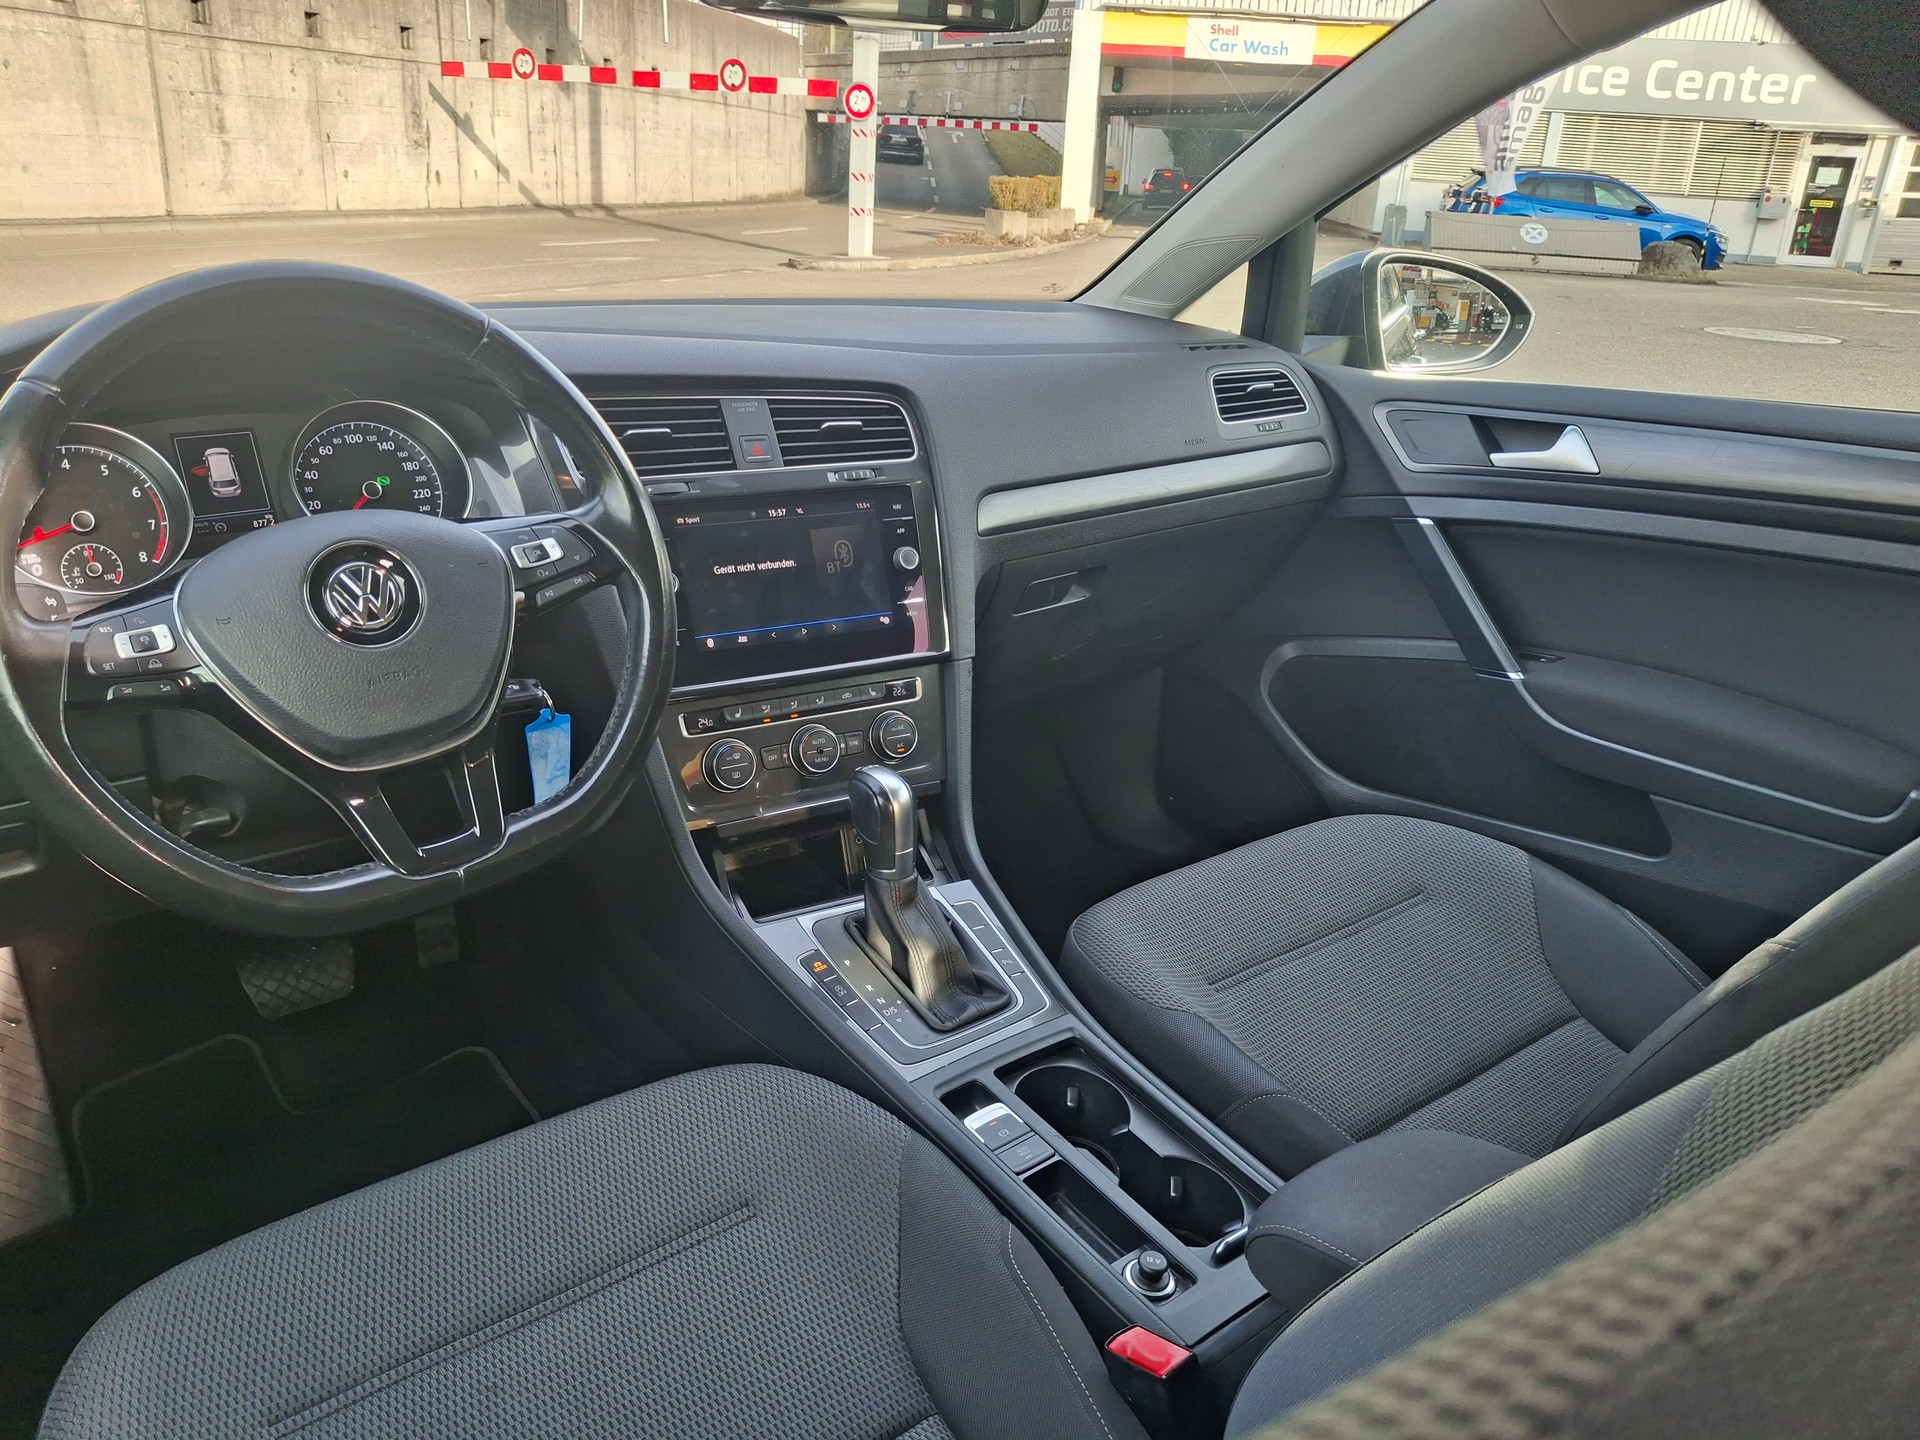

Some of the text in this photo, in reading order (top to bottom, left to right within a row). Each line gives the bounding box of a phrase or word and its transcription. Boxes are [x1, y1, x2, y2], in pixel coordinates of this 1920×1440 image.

[1210, 24, 1239, 36] Shell
[1209, 37, 1289, 56] Car Wash
[1645, 59, 1817, 105] Center
[332, 437, 342, 445] 80
[343, 433, 363, 444] 100
[318, 445, 333, 456] 60
[376, 441, 395, 452] 140
[61, 458, 71, 470] 4
[310, 457, 320, 465] 50
[401, 461, 420, 472] 180
[101, 464, 109, 476] 5
[304, 470, 319, 480] 40
[132, 486, 142, 498] 6
[413, 488, 431, 499] 220
[307, 500, 322, 510] 20
[685, 508, 787, 525] Sport 15:57
[148, 519, 156, 531] 7
[138, 551, 148, 563] 8
[532, 548, 543, 557] OK
[713, 558, 798, 575] Gerät nicht verbunden.
[826, 560, 841, 574] BT
[75, 577, 84, 585] 50
[103, 573, 116, 581] 130
[99, 625, 113, 634] RES
[102, 662, 116, 671] SET
[844, 959, 851, 967] P
[865, 984, 874, 992] R
[876, 996, 886, 1005] N
[882, 1006, 898, 1017] D/S
